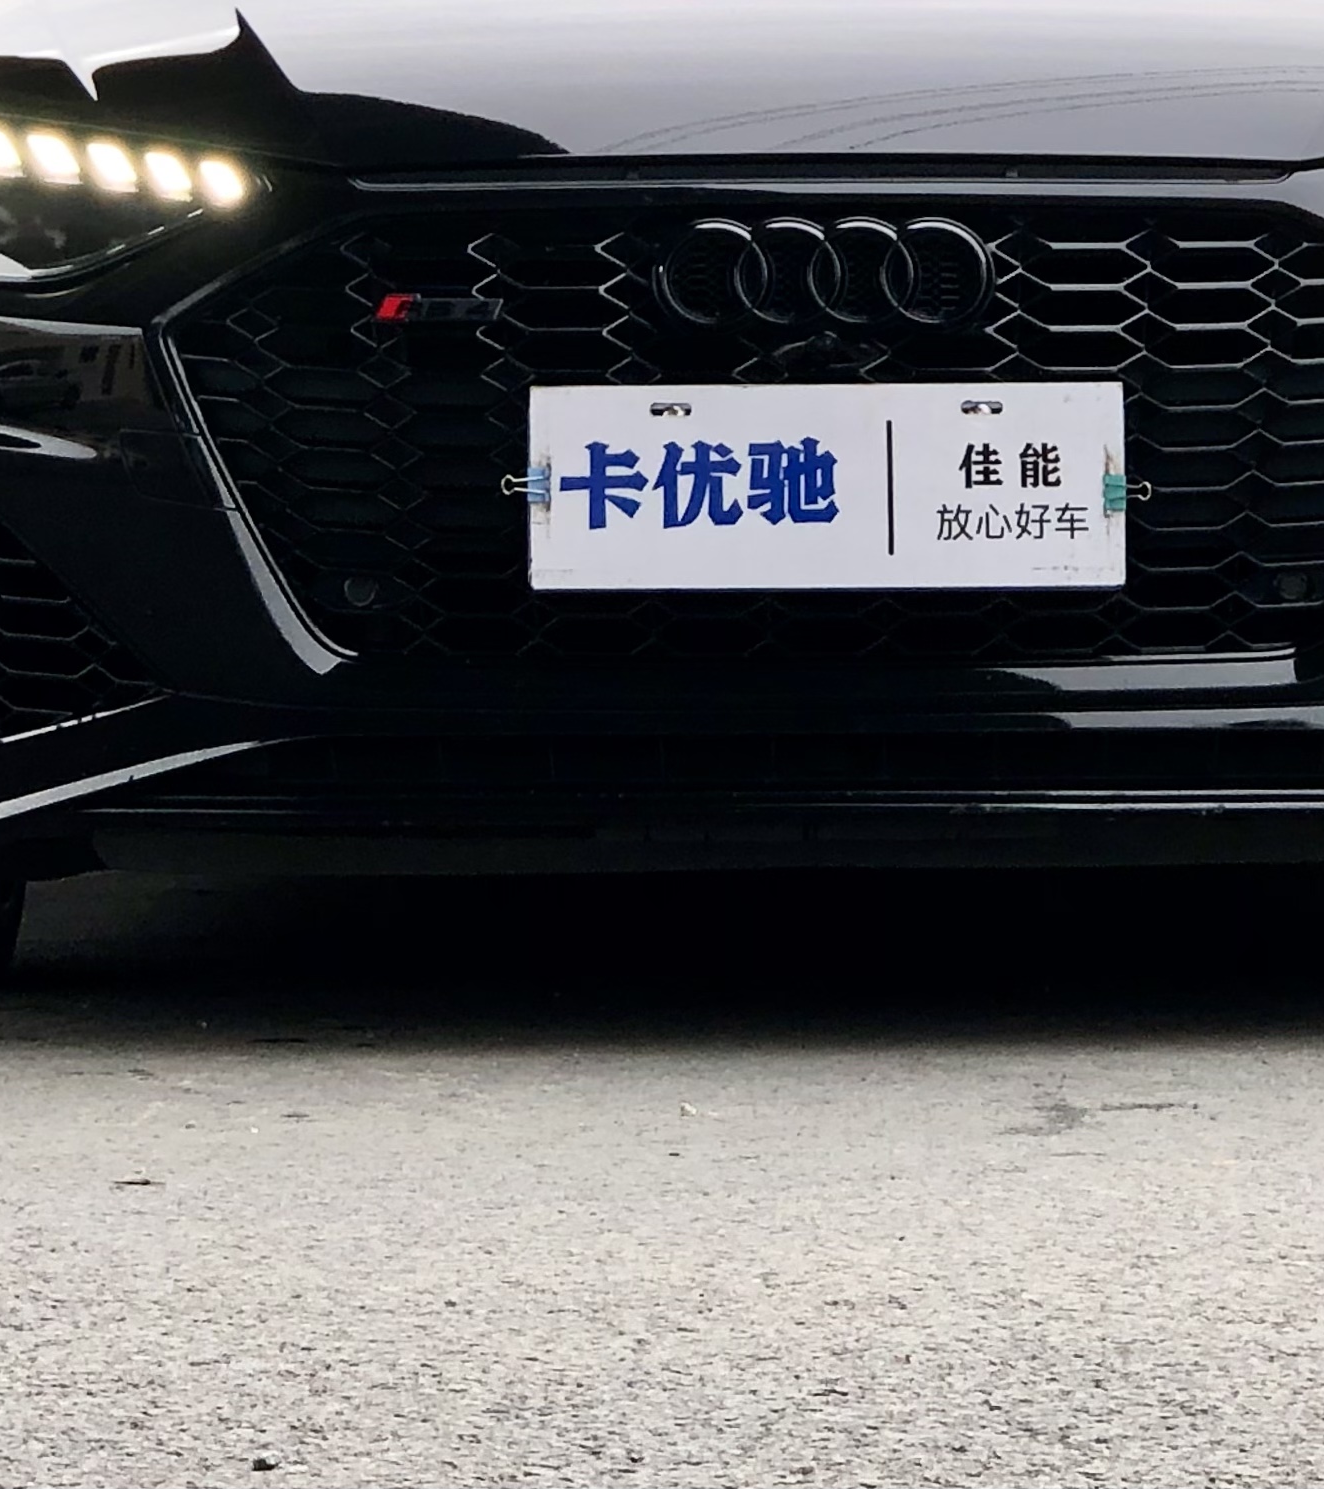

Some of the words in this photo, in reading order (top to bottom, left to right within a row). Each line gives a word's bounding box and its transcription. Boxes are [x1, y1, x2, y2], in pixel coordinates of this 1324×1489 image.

[559, 436, 840, 530] 卡优驰
[958, 442, 1062, 489] 佳能
[936, 502, 1089, 541] 放心好车
